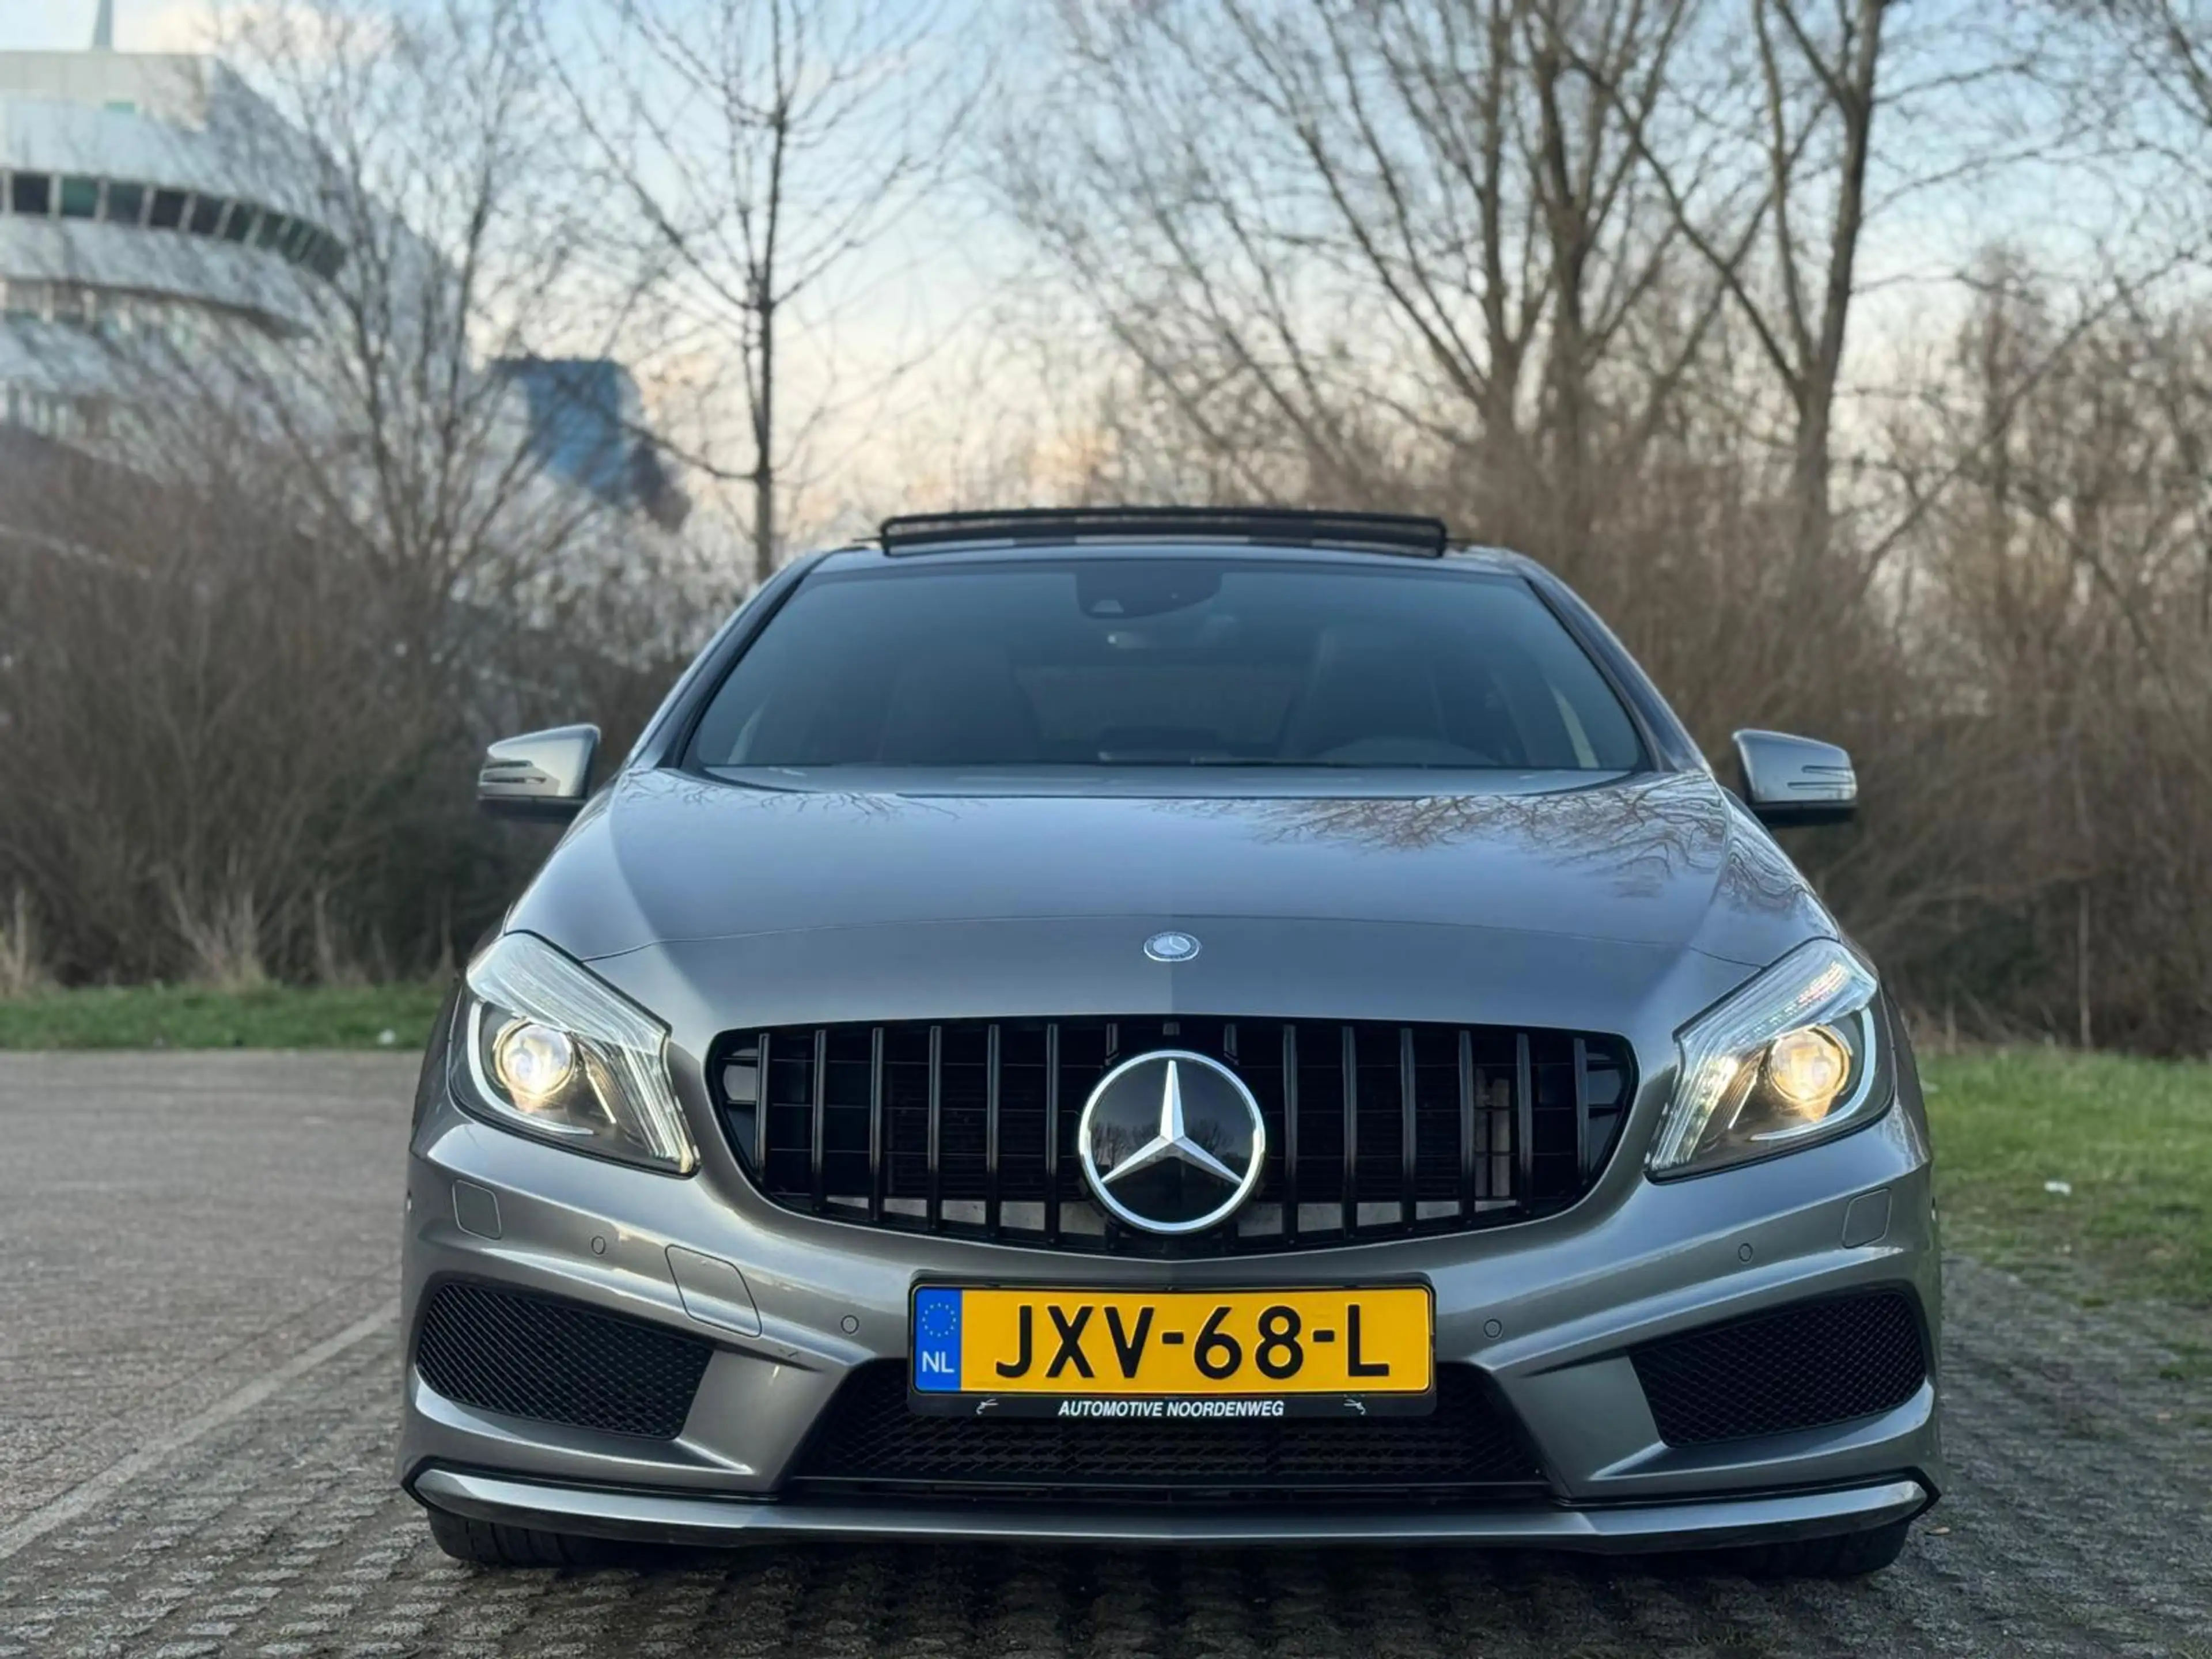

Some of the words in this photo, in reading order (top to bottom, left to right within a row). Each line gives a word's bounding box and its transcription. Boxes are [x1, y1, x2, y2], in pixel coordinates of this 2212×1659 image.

[995, 1305, 1389, 1380] JXV-68-L
[922, 1351, 955, 1373] NL
[1058, 1400, 1164, 1418] AUTOMOTIVE
[1166, 1400, 1285, 1417] NOORDENWEG
